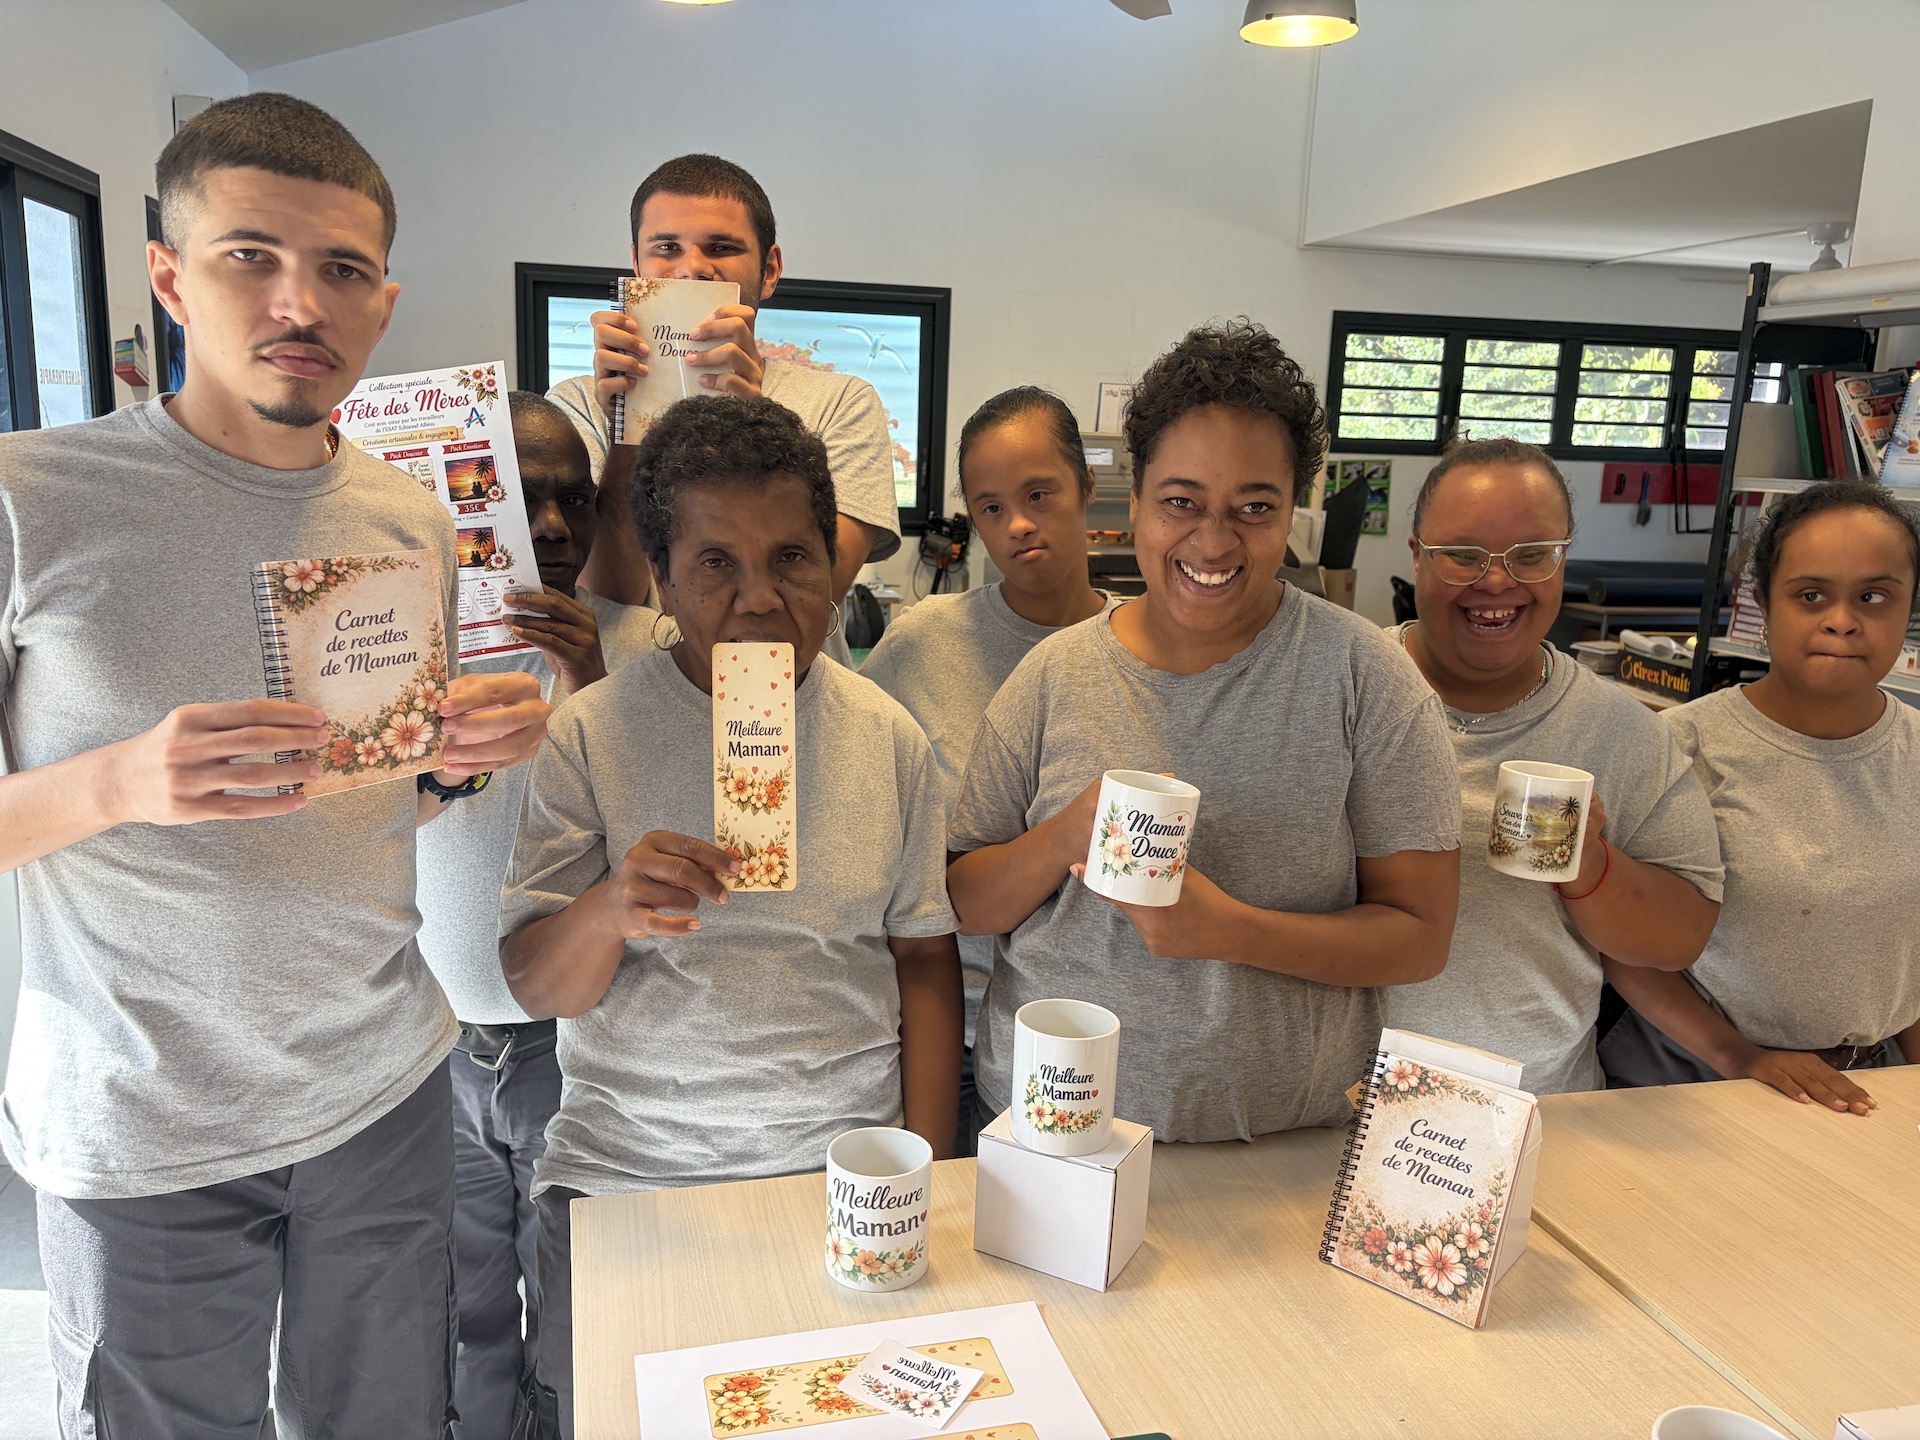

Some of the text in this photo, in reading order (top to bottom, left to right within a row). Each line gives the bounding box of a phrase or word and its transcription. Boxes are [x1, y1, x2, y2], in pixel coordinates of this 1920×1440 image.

[652, 324, 697, 341] Mam
[659, 342, 697, 357] Dou
[369, 377, 433, 392] Collection spéciale
[344, 388, 471, 423] Fête des Mères
[418, 413, 445, 422] travailleurs
[362, 437, 388, 447] Créations
[388, 433, 418, 443] artisanales
[425, 430, 449, 440] engagées
[450, 444, 462, 452] Pack
[463, 503, 480, 512] 35€
[335, 608, 396, 631] Carnet
[326, 629, 409, 653] de recettes
[320, 651, 419, 677] de Maman
[1633, 660, 1659, 684] Cirex
[726, 720, 783, 737] Meilleure
[728, 741, 781, 758] Maman
[1127, 809, 1186, 836] Maman
[1131, 836, 1179, 859] Douce
[1040, 1064, 1095, 1084] Meilleure
[1042, 1083, 1091, 1101] Maman
[1410, 1119, 1467, 1151] Carnet
[1394, 1136, 1473, 1174] de recettes
[1382, 1154, 1475, 1198] de Maman
[833, 1178, 924, 1210] Meilleure
[837, 1208, 919, 1237] Maman
